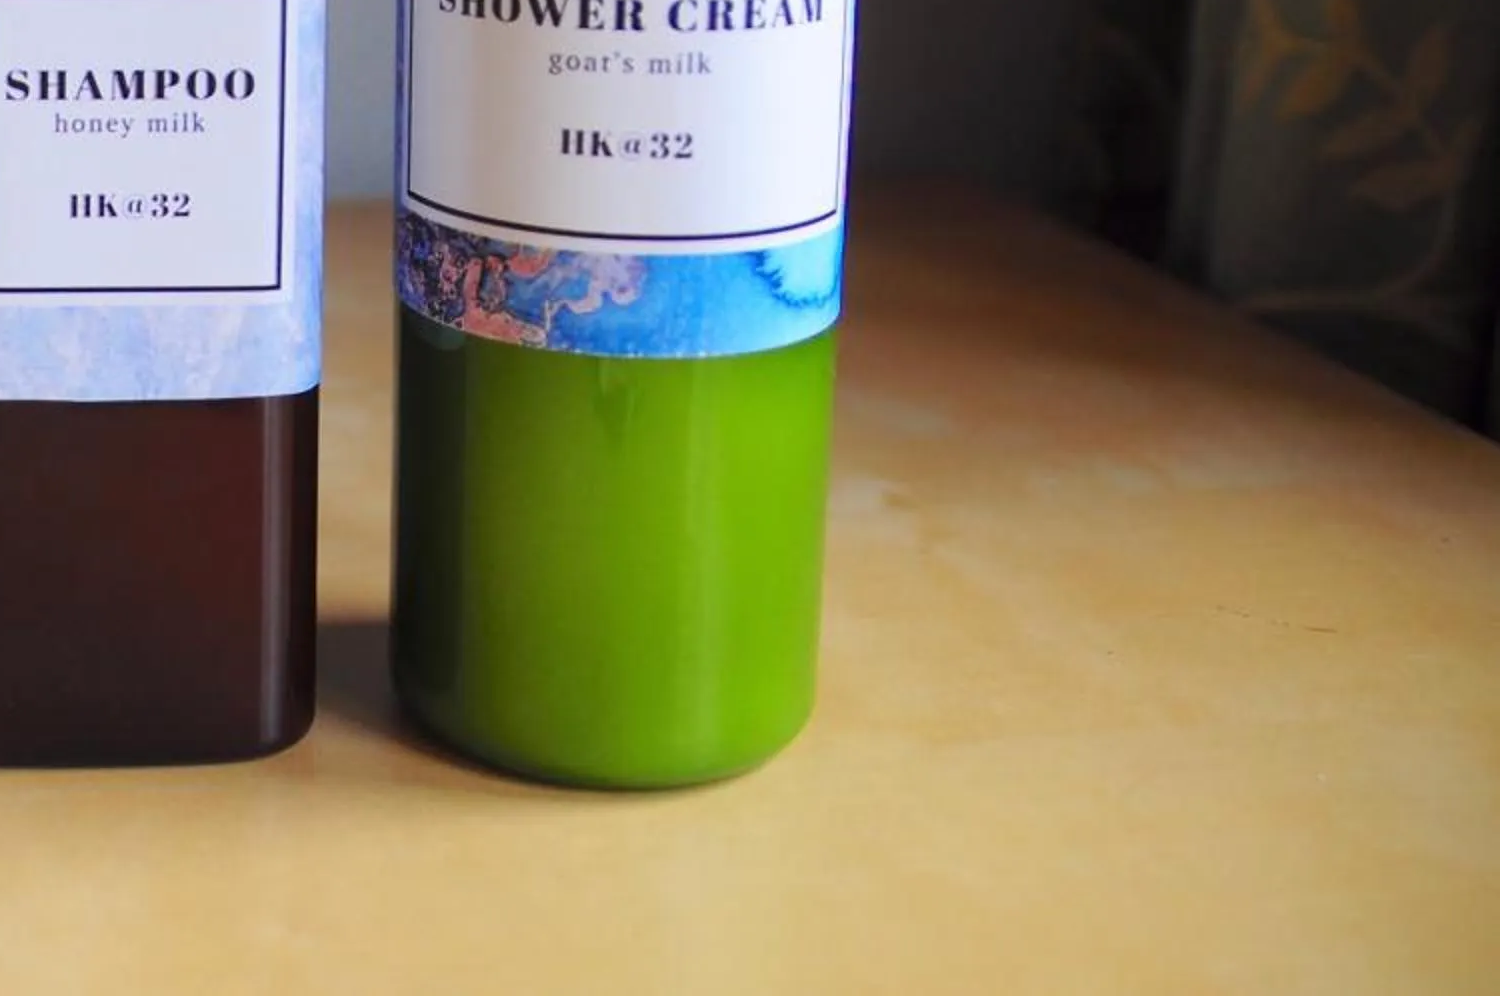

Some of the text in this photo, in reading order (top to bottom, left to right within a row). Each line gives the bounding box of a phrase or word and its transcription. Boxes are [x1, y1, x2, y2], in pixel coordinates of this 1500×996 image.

[547, 53, 713, 75] goat's milk
[4, 67, 257, 102] SHAMPOO
[54, 111, 206, 139] honey milk
[559, 128, 695, 161] HK@32
[68, 192, 192, 220] HK@32
